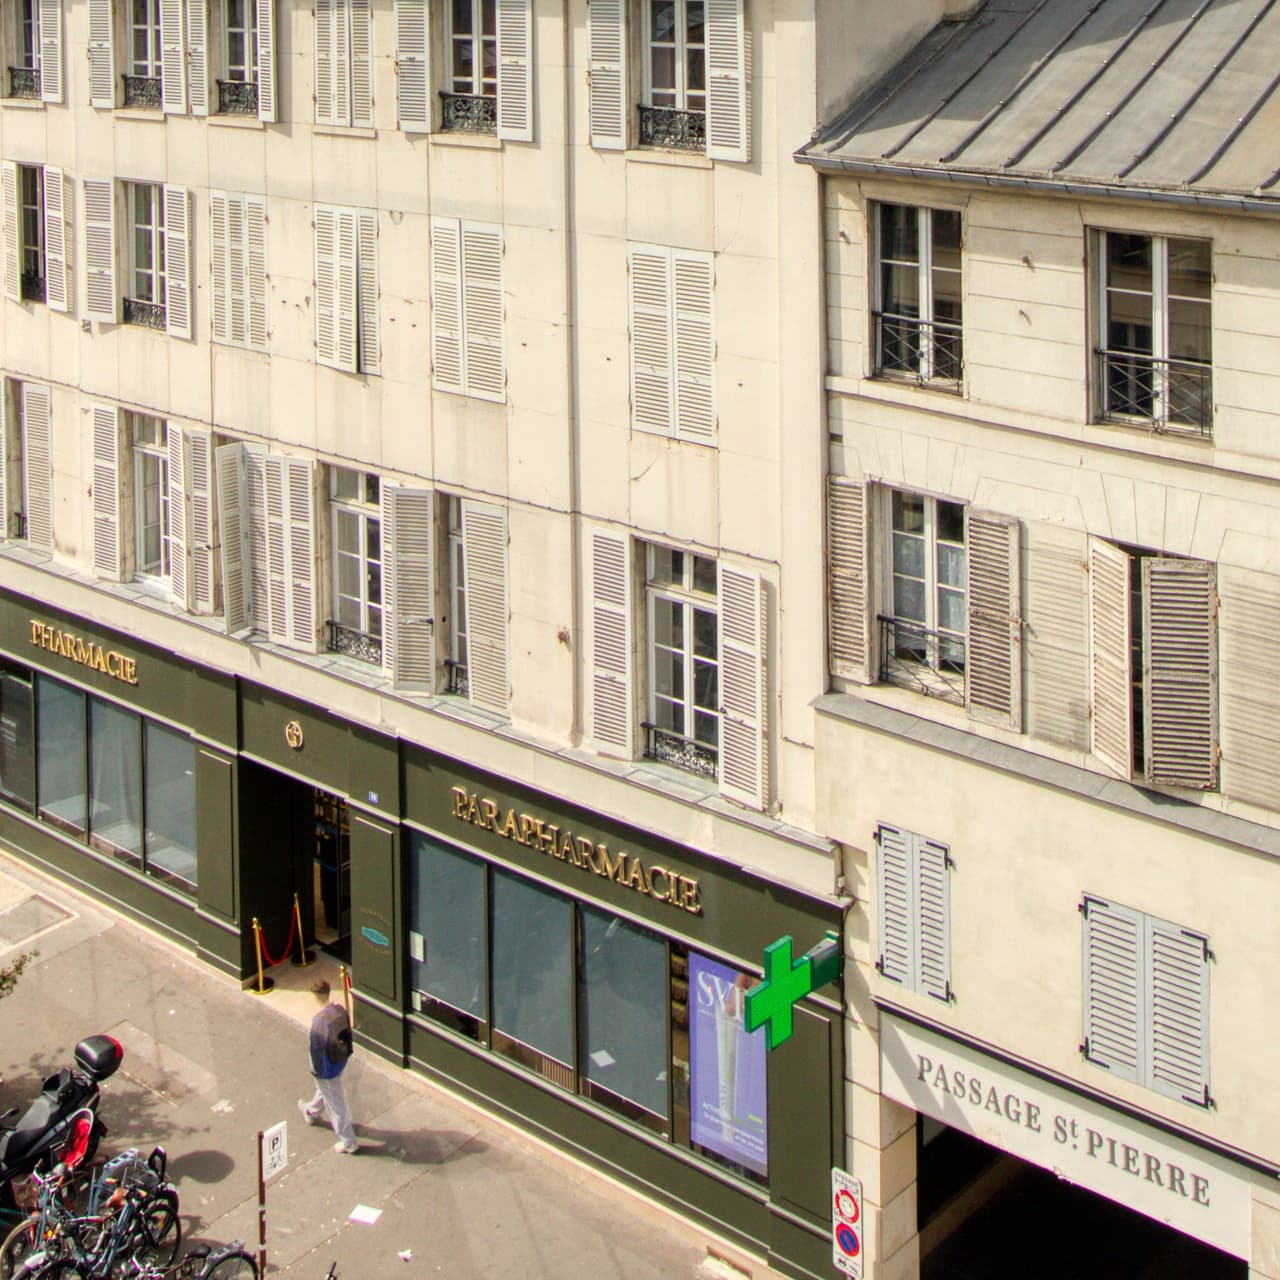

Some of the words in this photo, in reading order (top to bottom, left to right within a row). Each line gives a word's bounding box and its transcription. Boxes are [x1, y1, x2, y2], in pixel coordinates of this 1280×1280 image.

[29, 620, 138, 685] PHARMACIE
[451, 786, 702, 913] PARAPHARMACIE
[271, 1136, 279, 1150] P
[916, 1054, 1041, 1133] PASSAGE
[1086, 1128, 1211, 1207] PIERRE
